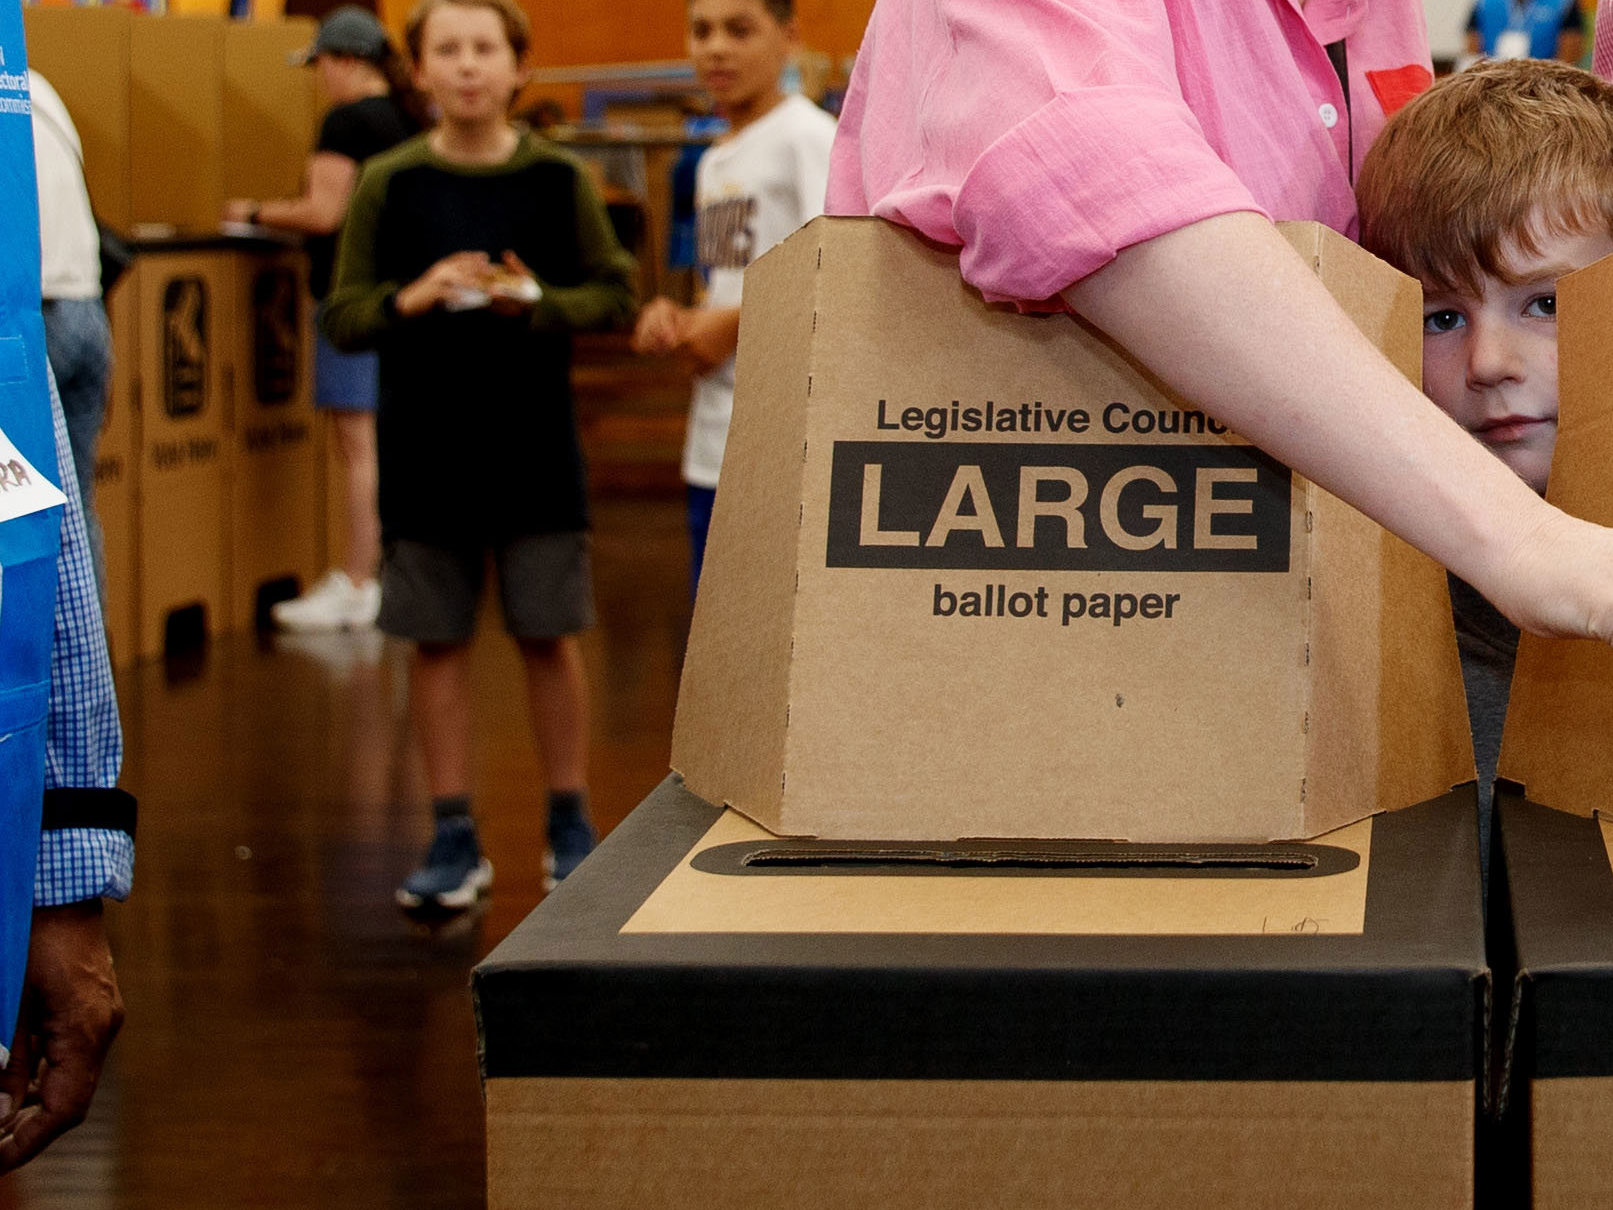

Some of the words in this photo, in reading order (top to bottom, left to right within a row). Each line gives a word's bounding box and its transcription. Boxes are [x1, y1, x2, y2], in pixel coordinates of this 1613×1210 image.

[877, 399, 1091, 439] Legislative
[1102, 402, 1235, 435] Counc
[858, 463, 1259, 551] LARGE
[932, 583, 1049, 619] ballot
[1061, 592, 1181, 627] paper
